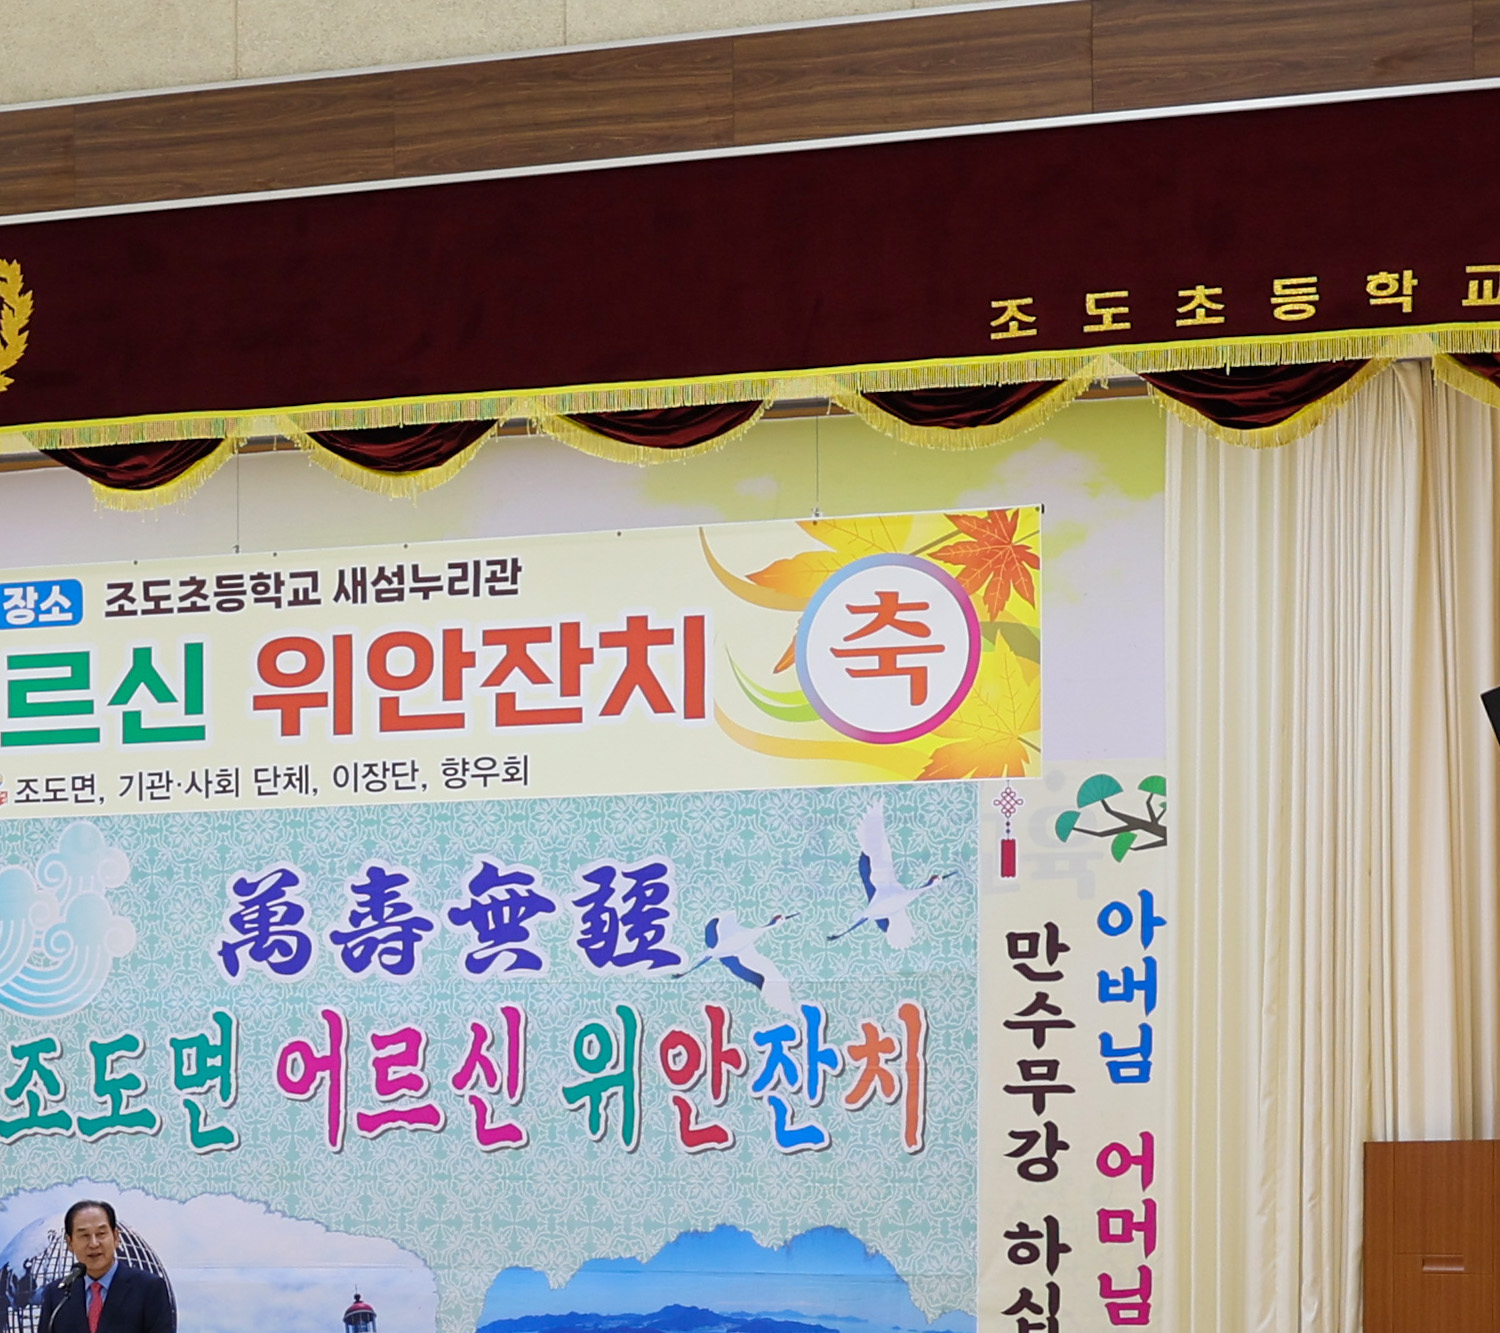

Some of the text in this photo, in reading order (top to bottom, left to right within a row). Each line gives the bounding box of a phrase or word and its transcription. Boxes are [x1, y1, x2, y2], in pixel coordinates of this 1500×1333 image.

[1, 586, 74, 624] 장소
[105, 558, 522, 617] 조도초등학교 새섬누리관
[253, 615, 705, 736] 위안잔치
[828, 590, 946, 706] 축
[15, 774, 104, 804] 조도면,
[120, 768, 238, 801] 기관·사회
[255, 765, 317, 796] 단체,
[334, 760, 426, 792] 이장단,
[442, 755, 527, 789] 향우회
[276, 1003, 528, 1150] 어르신
[561, 1002, 928, 1154] 위안잔치
[1003, 922, 1075, 1182] 만수무강
[1096, 889, 1167, 1326] 아버님 어머님
